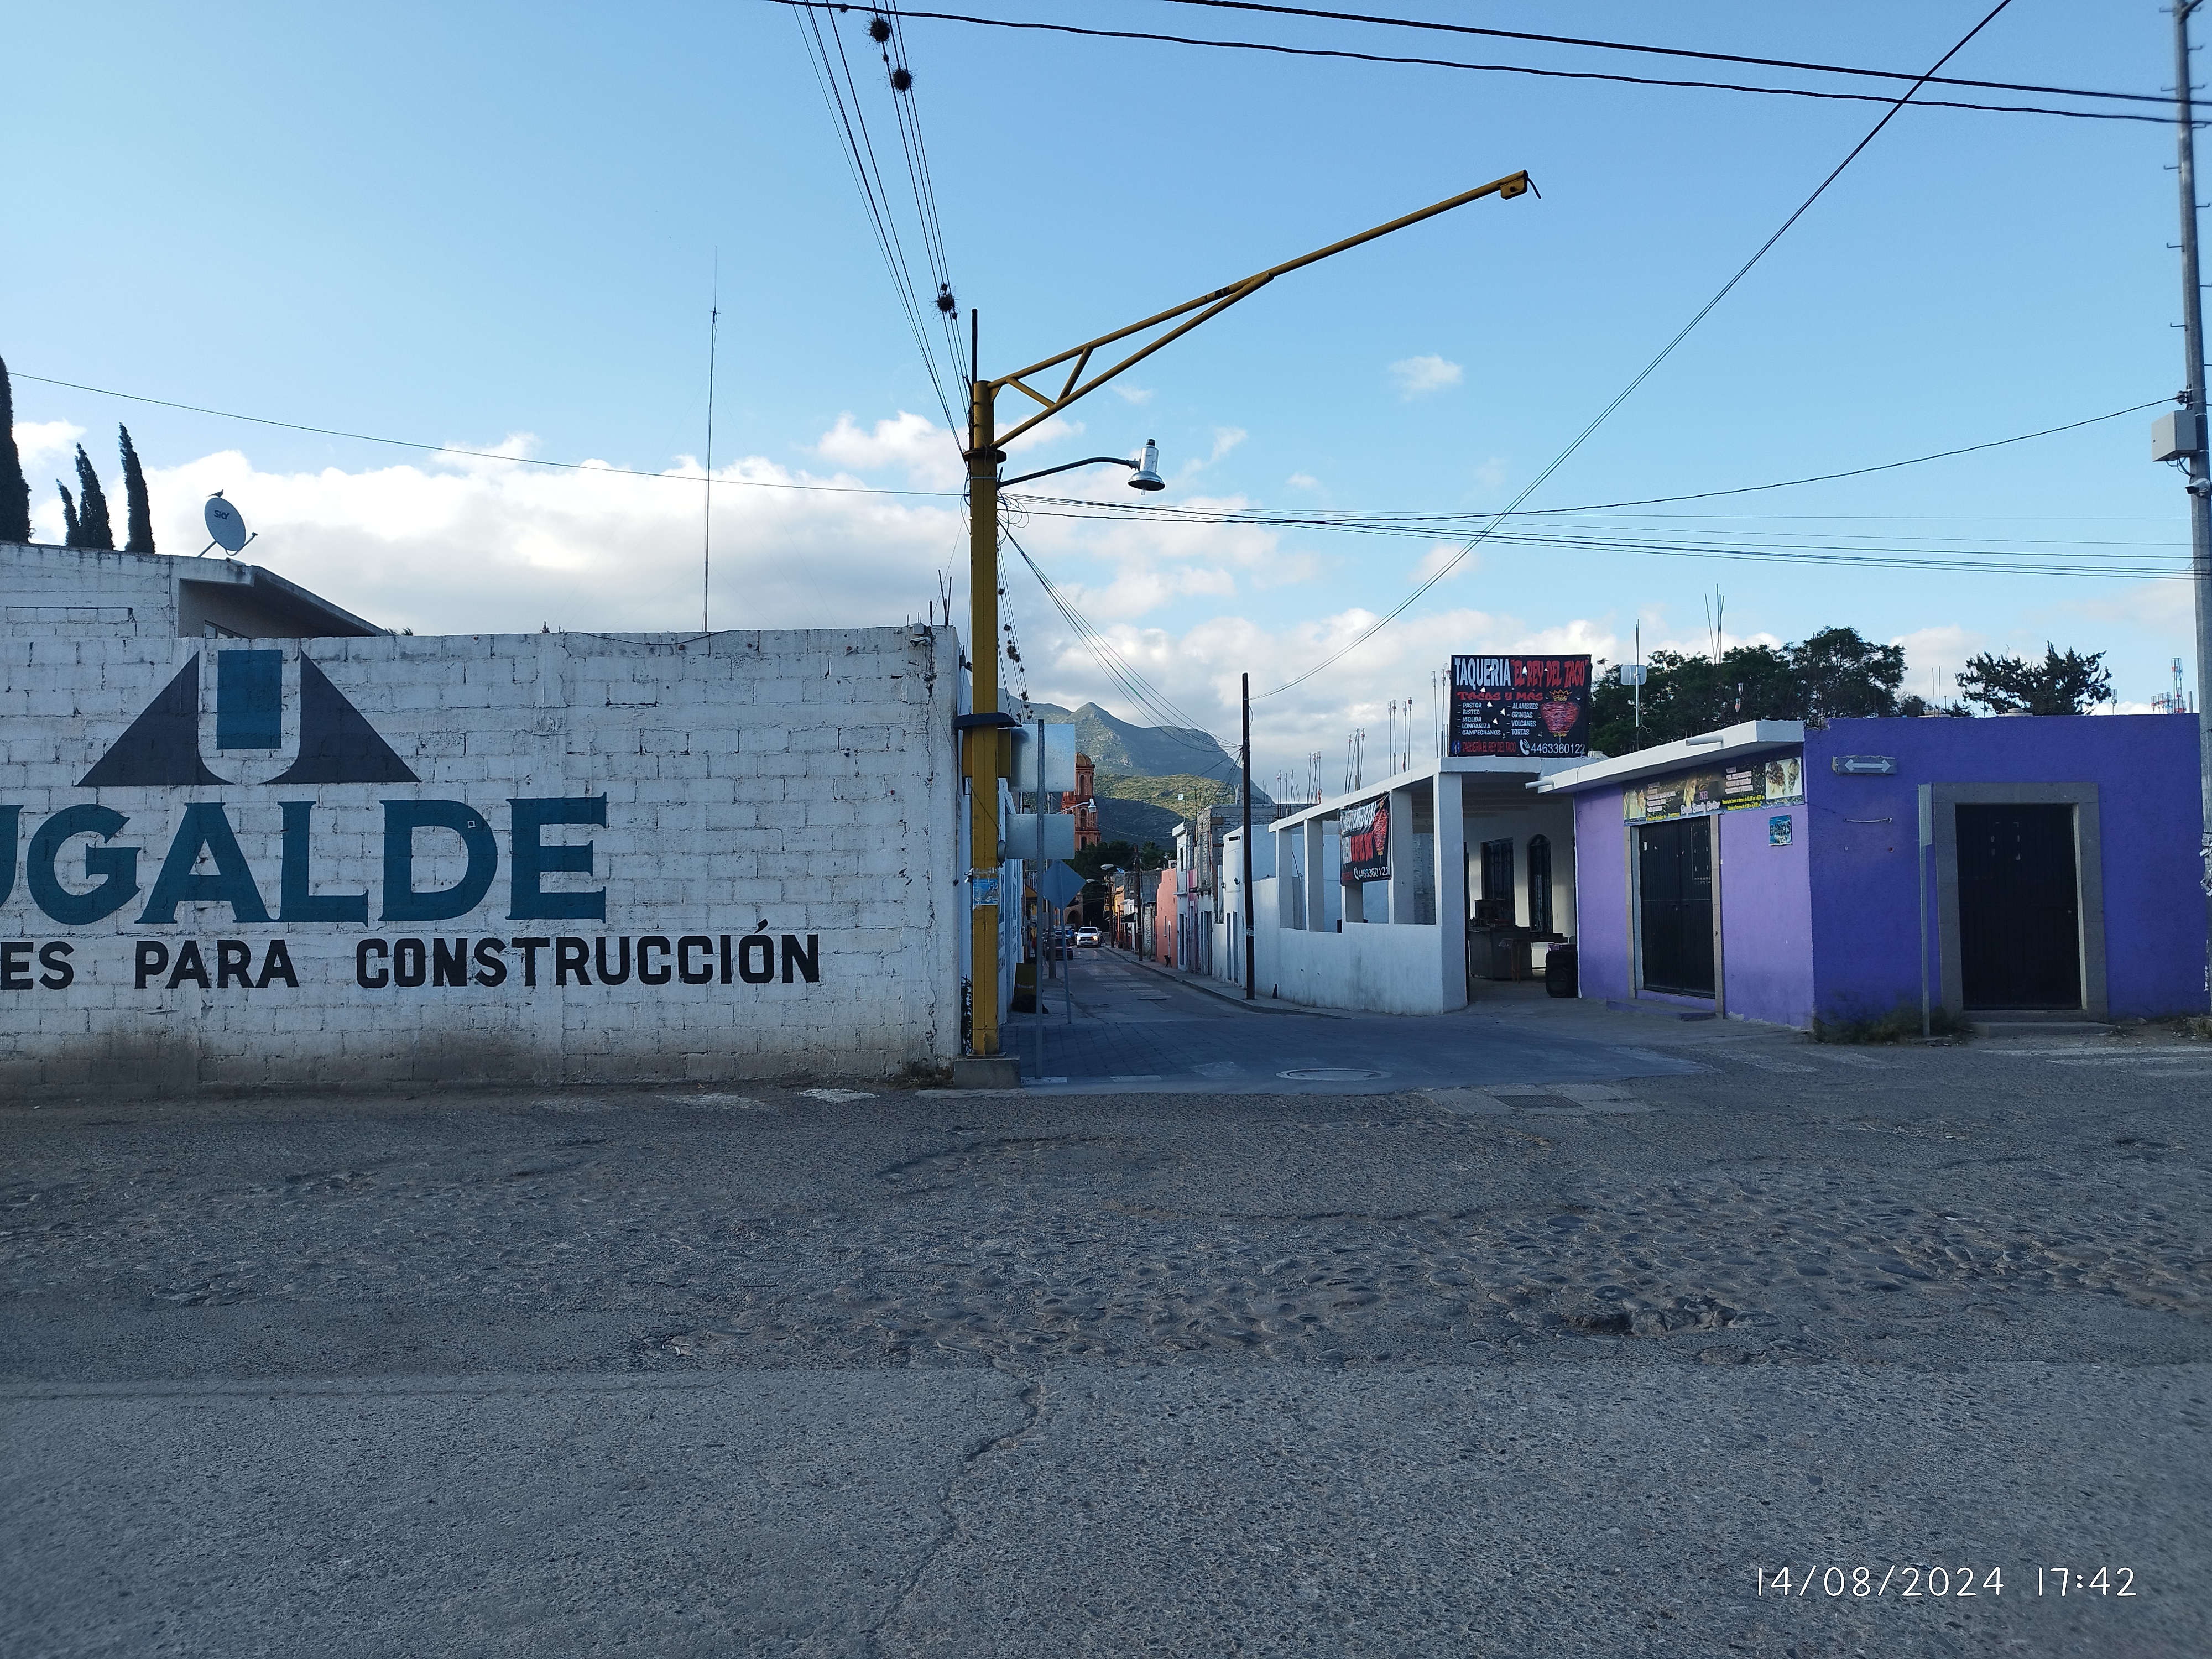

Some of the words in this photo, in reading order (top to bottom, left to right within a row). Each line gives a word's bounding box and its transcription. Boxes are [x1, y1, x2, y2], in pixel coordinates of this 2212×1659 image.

[214, 510, 230, 520] SKY
[1454, 658, 1511, 691] TAQUERIA
[1527, 660, 1543, 687] REY
[1546, 660, 1562, 687] DEL
[1457, 692, 1501, 700] TACOS
[1699, 791, 1708, 800] NR
[0, 791, 607, 927] GALDE
[134, 939, 299, 989] PARA
[356, 919, 820, 988] CONSTRUCCIÓN
